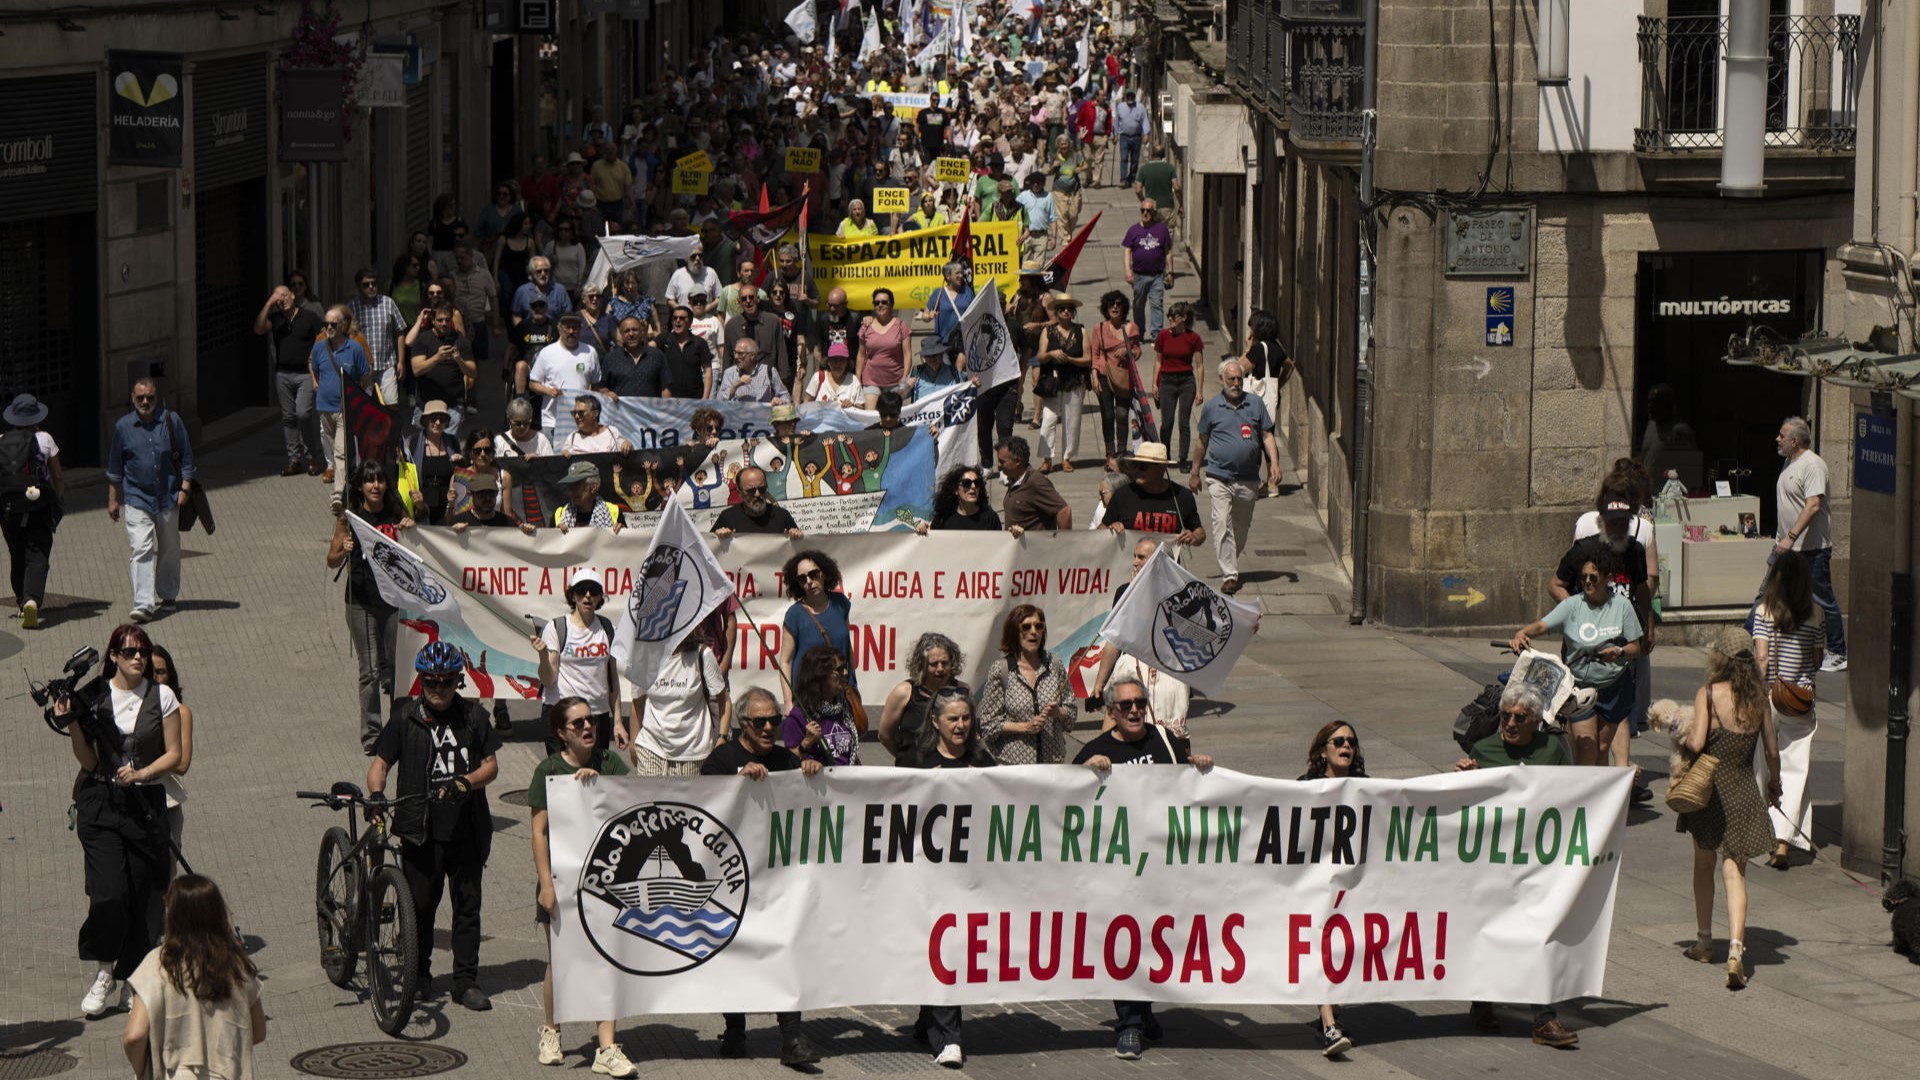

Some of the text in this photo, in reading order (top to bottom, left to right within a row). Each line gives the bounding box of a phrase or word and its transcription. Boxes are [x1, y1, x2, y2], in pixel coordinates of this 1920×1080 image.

[114, 114, 180, 128] HELADERÍA
[287, 108, 335, 121] nonna&go
[789, 150, 817, 159] ALTRI
[792, 157, 814, 167] NÃO
[940, 160, 966, 169] ENCE
[680, 171, 702, 180] ALTRI
[682, 178, 699, 187] NON
[878, 190, 905, 198] ENCE
[1472, 220, 1505, 230] PASEO
[1479, 232, 1494, 242] DE
[820, 238, 901, 261] ESPAZO
[910, 233, 1009, 260] NATRAL
[1464, 244, 1512, 255] ANTONIO
[831, 261, 880, 280] PÚBLICO
[1455, 257, 1517, 268] ODRIOZOLA
[639, 426, 679, 450] na
[1860, 448, 1895, 468] PEREGRIN
[1134, 511, 1178, 534] ALTRI
[462, 566, 529, 596] DENDE
[538, 567, 553, 595] A
[563, 566, 633, 596] UOA
[863, 570, 924, 599] AUGA
[934, 570, 945, 599] E
[955, 570, 1003, 599] AIRE
[1011, 569, 1047, 597] SON
[1058, 568, 1110, 595] VIDA!
[1163, 595, 1192, 614] Pola
[1217, 605, 1228, 623] da
[1219, 623, 1232, 646] RIA
[768, 804, 846, 869] NIN
[862, 803, 973, 865] ENCE
[986, 804, 1043, 863] NA
[1060, 786, 1149, 877] RÍA,
[1165, 804, 1242, 866] NIN
[1254, 804, 1373, 866] ALTRI
[1385, 804, 1439, 864] NA
[583, 808, 745, 895] Pola Defensa da RIA
[928, 889, 1449, 986] CELULOSAS FÓRA!
